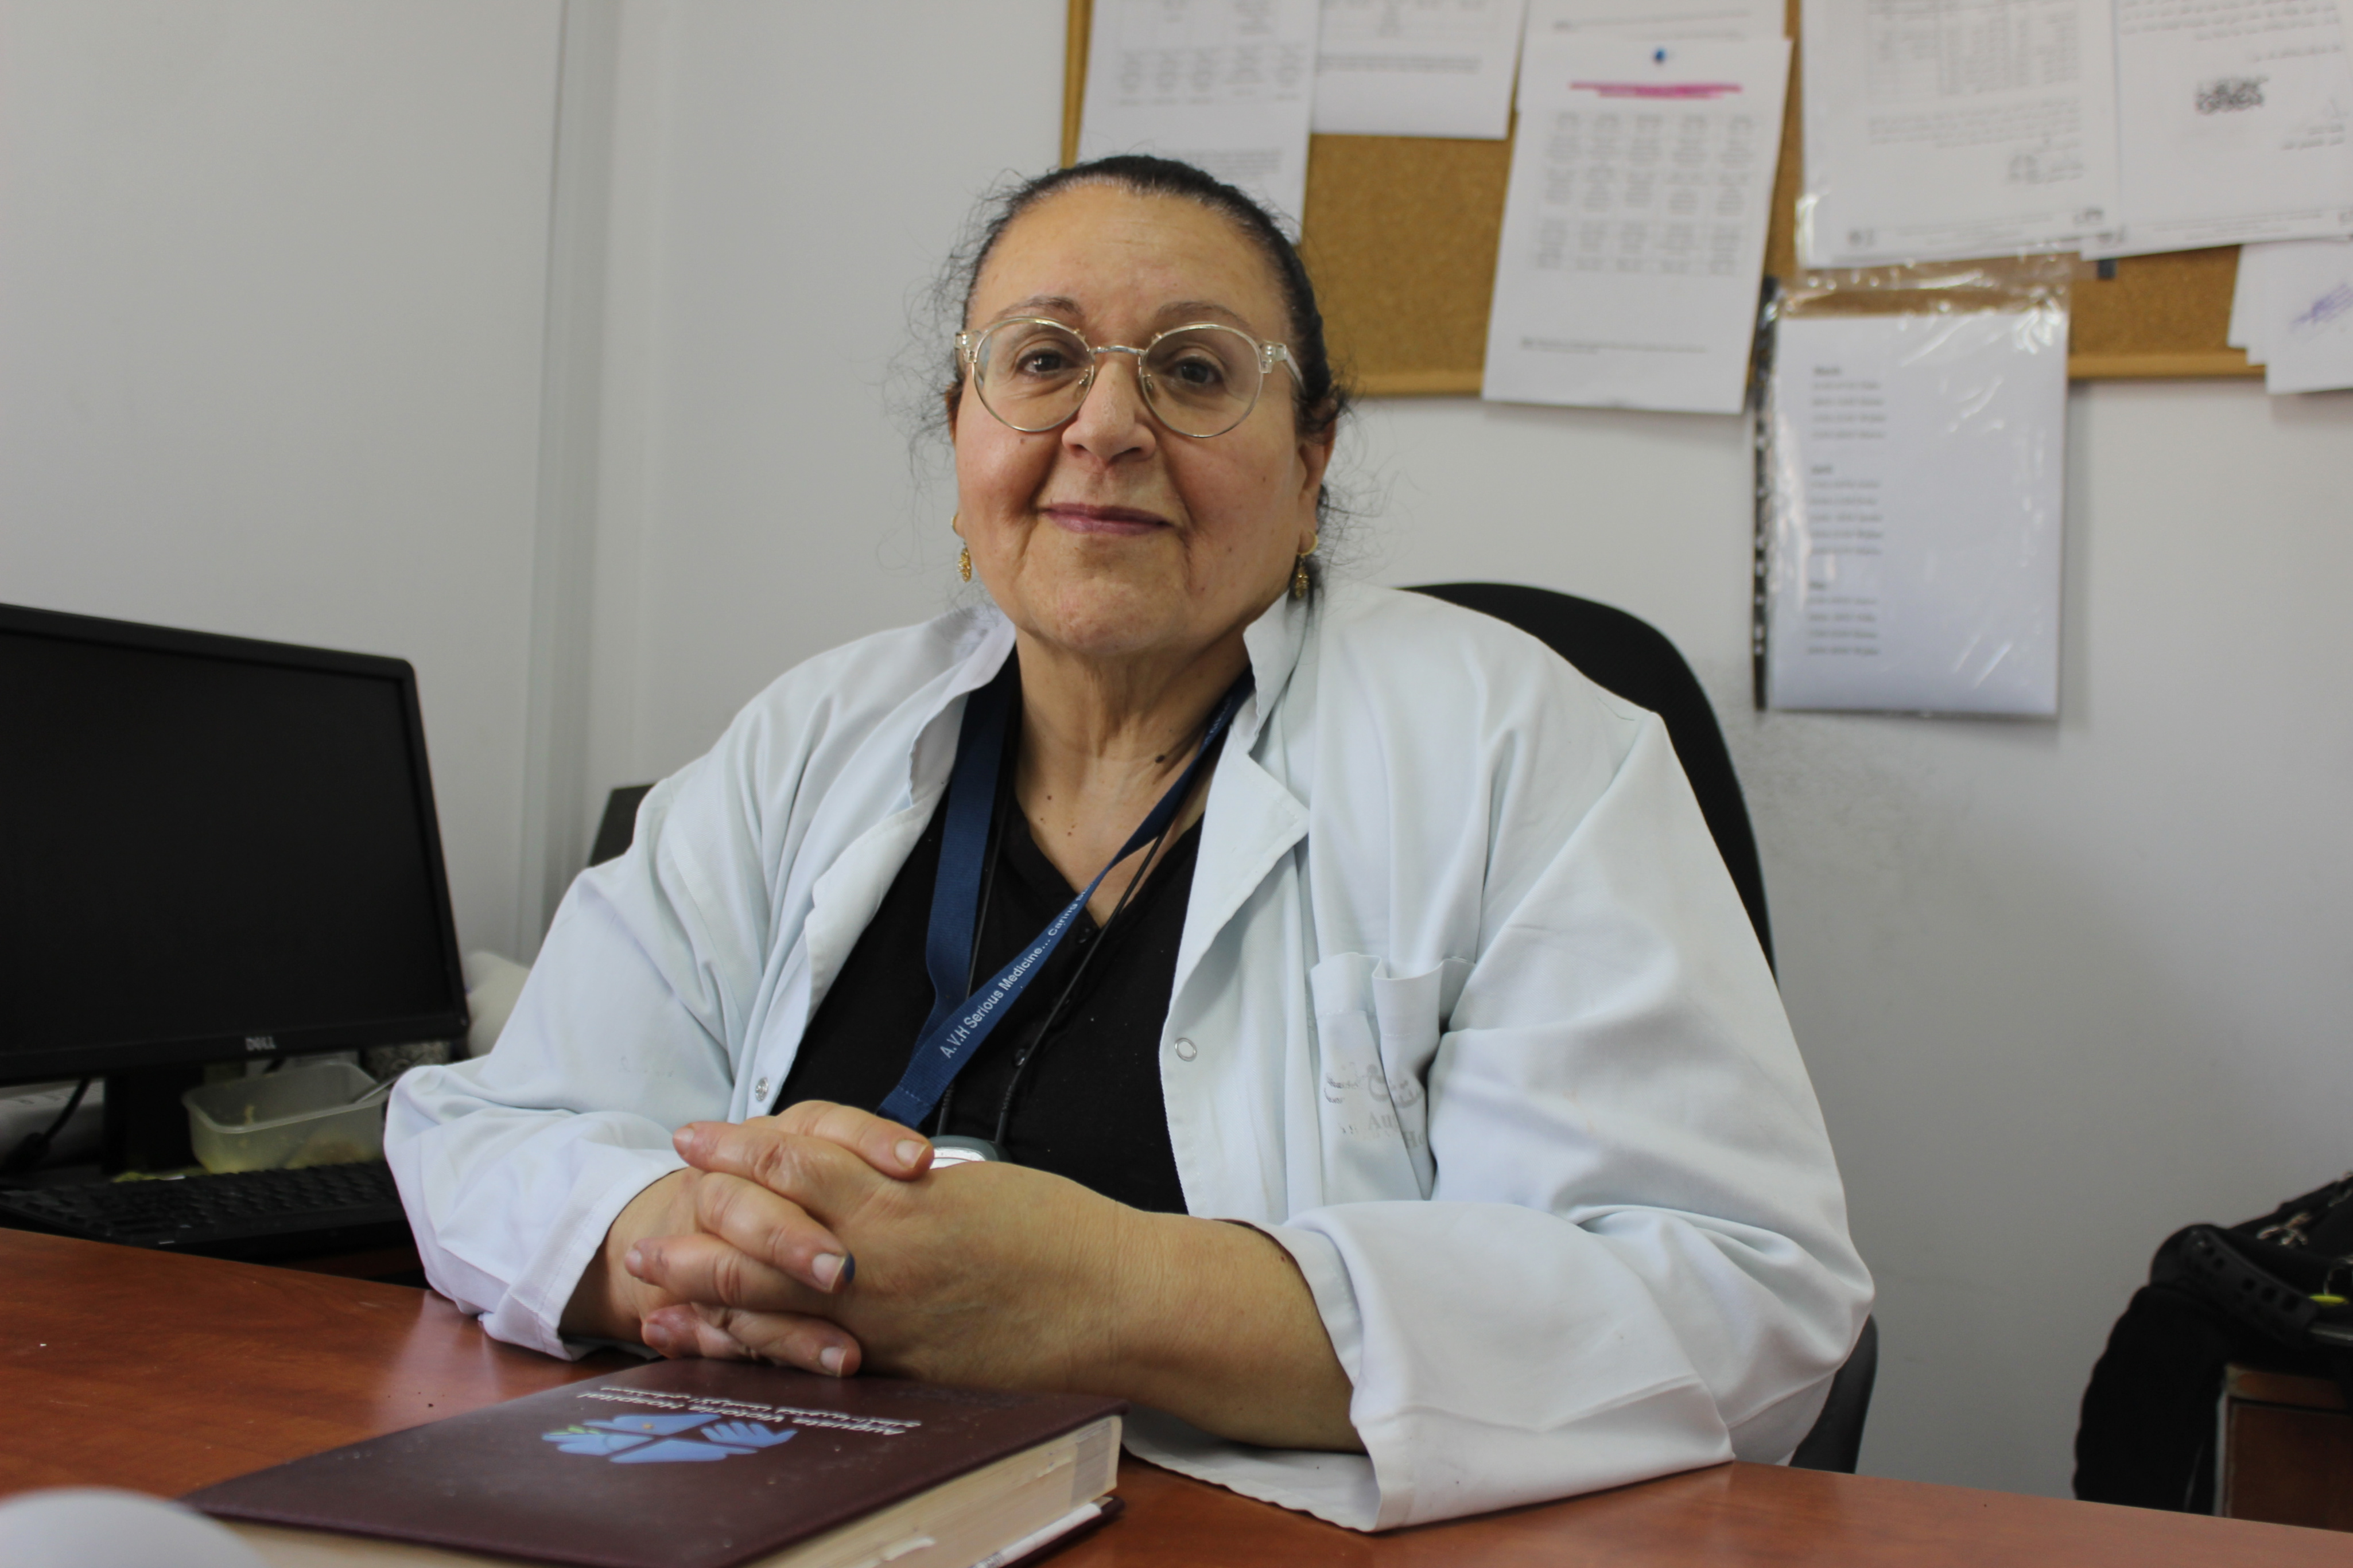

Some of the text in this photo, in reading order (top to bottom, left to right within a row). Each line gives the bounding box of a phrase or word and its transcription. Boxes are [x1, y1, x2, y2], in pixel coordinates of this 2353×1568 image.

[245, 1036, 277, 1051] DELL
[939, 1025, 970, 1059] A.V.H
[963, 990, 1004, 1029] Serious
[576, 1392, 906, 1435] Augusta Victoria Hospital
